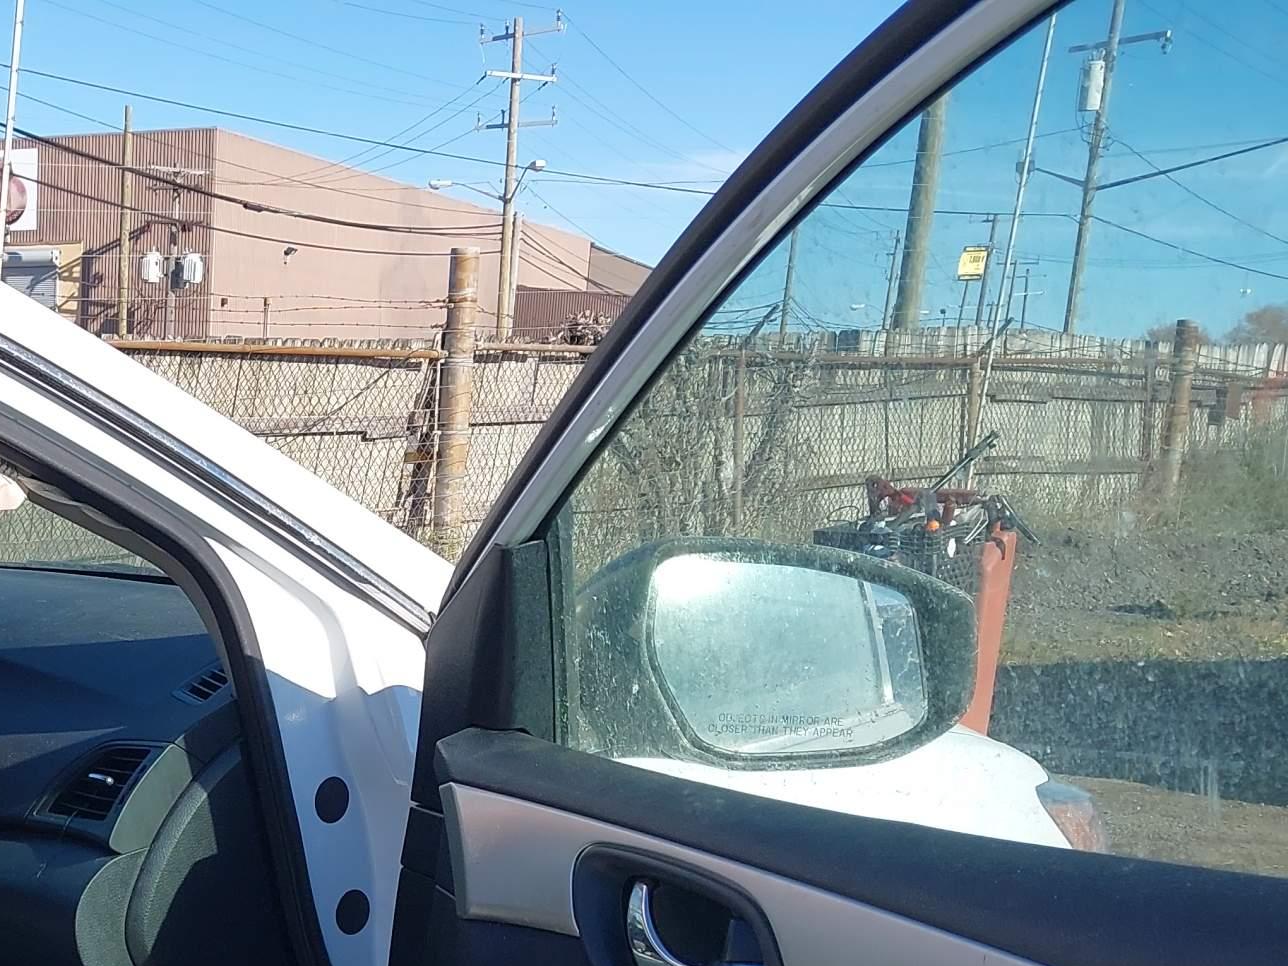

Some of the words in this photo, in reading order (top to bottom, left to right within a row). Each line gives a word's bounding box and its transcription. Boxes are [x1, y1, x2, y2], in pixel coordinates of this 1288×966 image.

[823, 717, 844, 727] ARE
[708, 723, 747, 734] CLOSER
[750, 725, 778, 736] THAN
[783, 726, 808, 737] THEY
[813, 727, 854, 738] APPEAR
